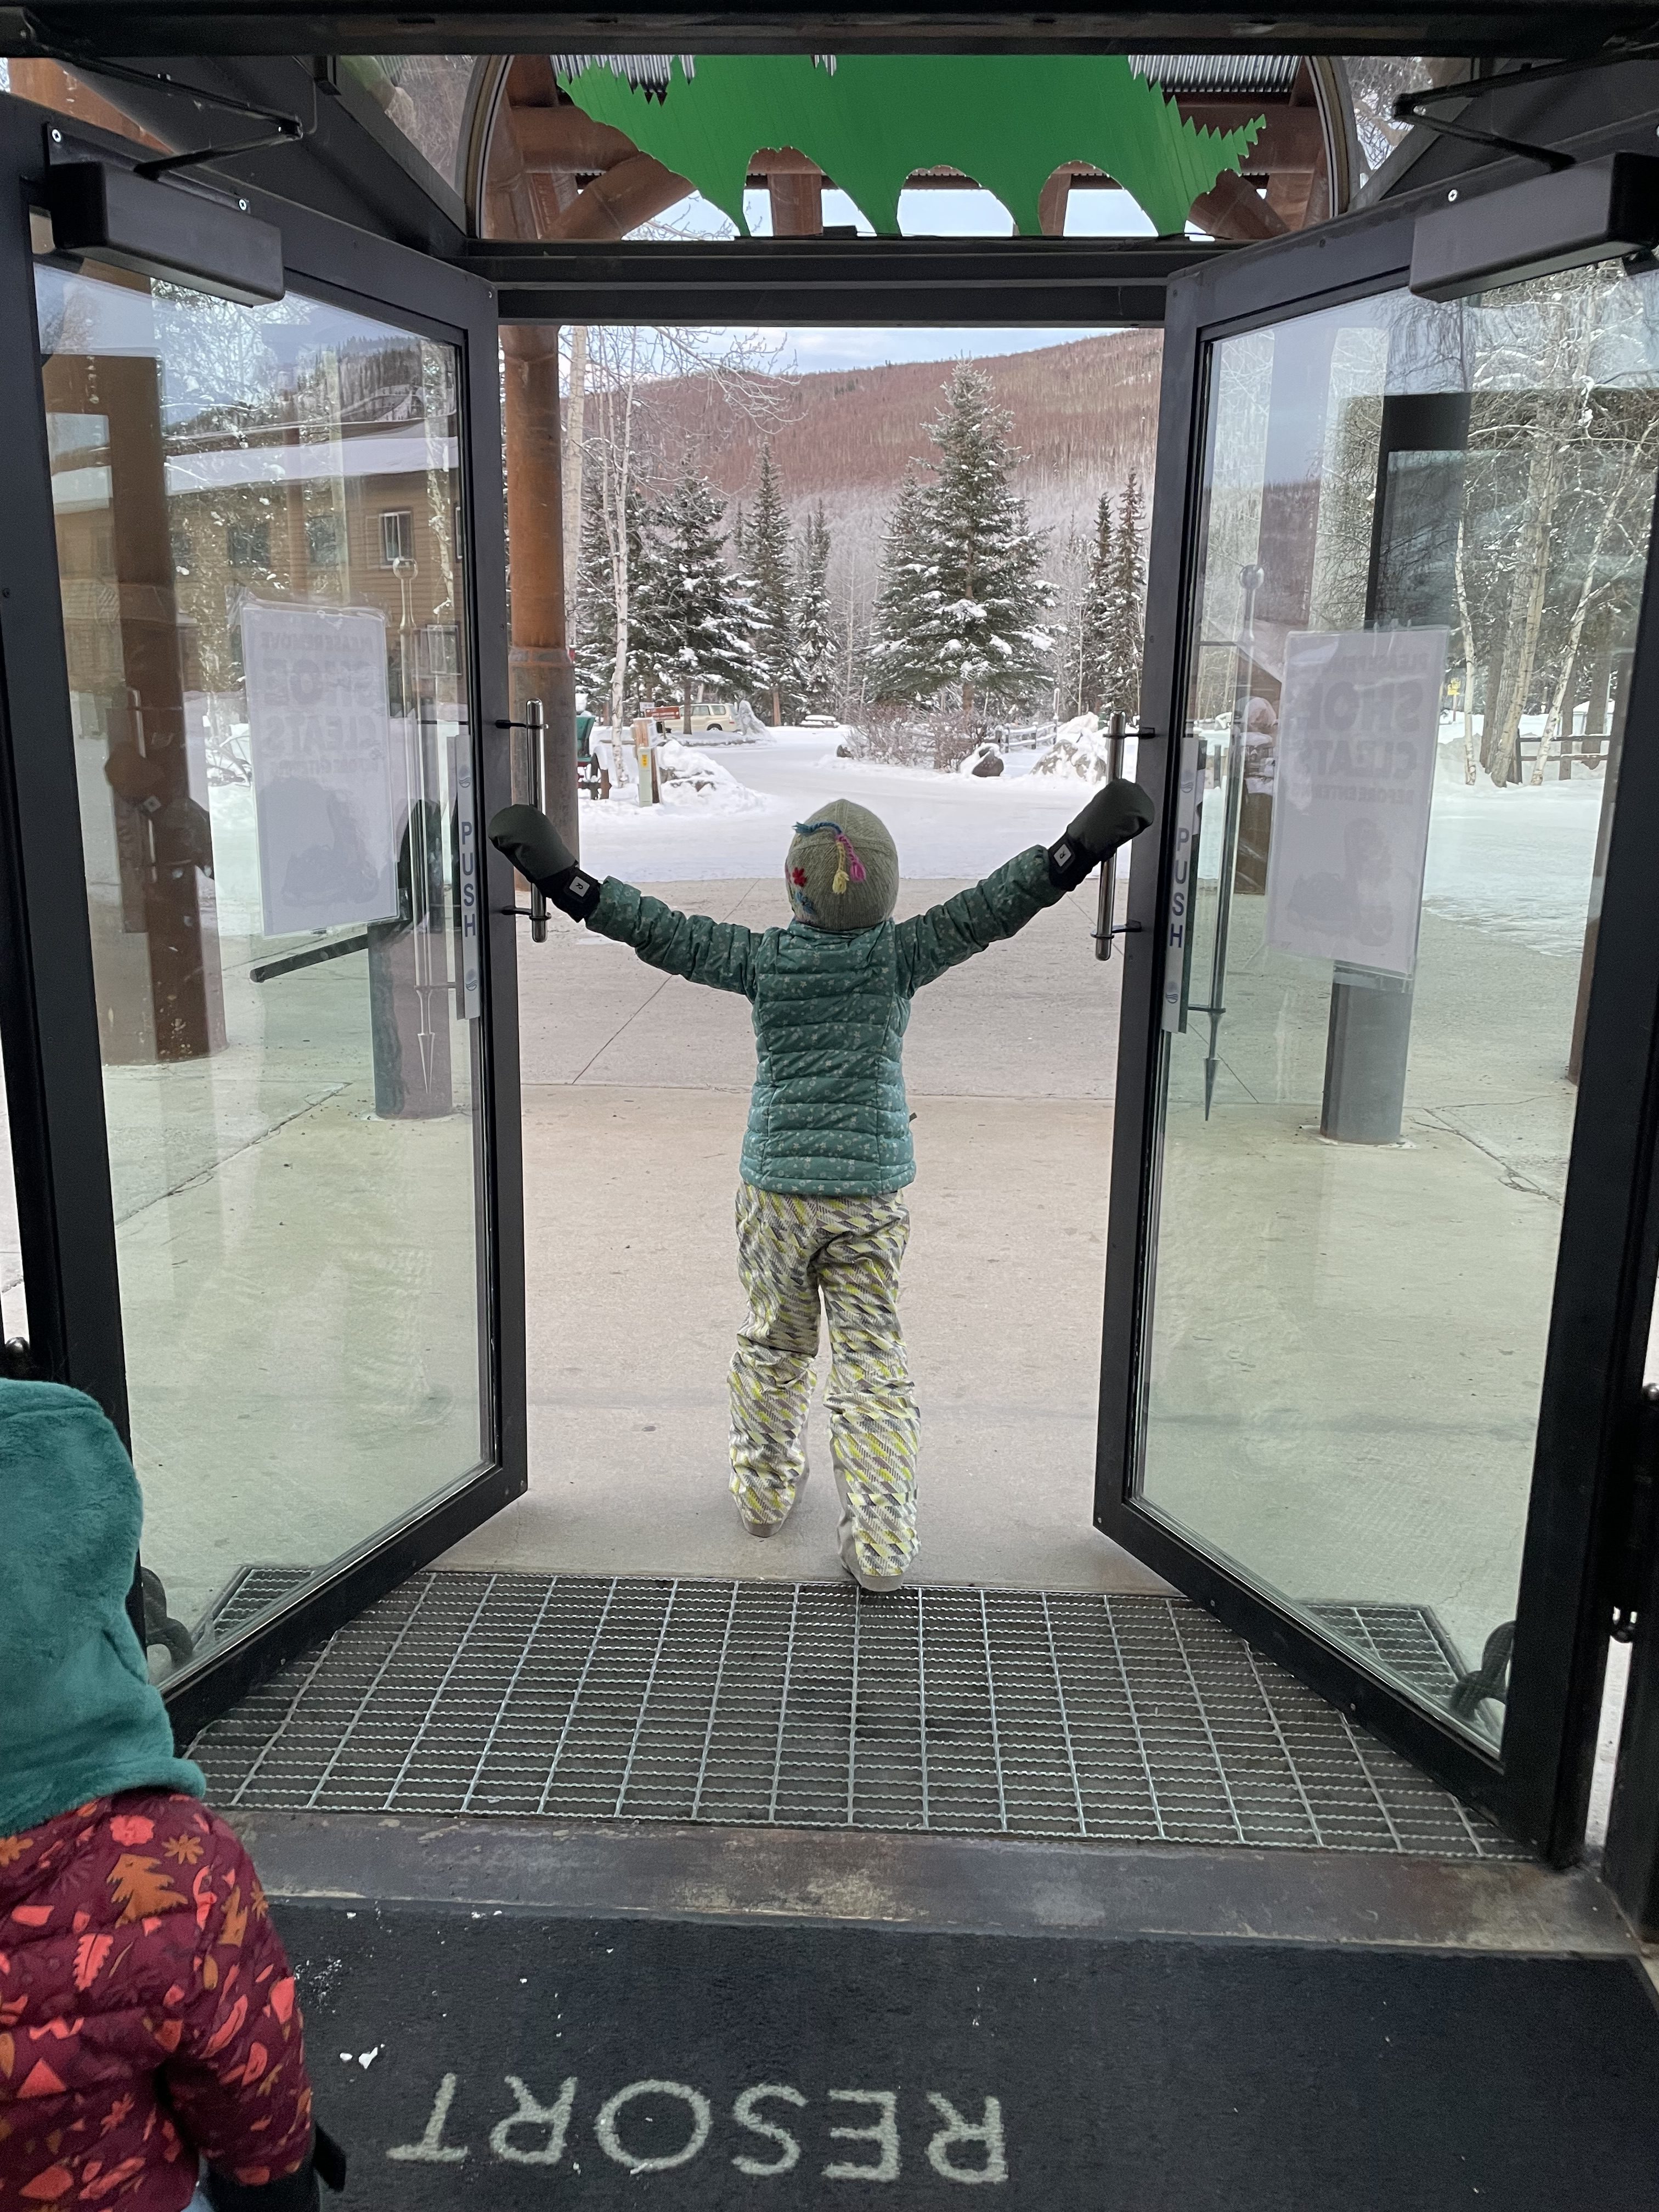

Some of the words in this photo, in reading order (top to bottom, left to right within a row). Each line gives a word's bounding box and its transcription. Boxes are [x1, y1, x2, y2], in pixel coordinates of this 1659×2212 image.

[461, 821, 476, 937] PUSH
[1169, 827, 1189, 948] PUSH
[386, 2073, 1008, 2183] RESORT
